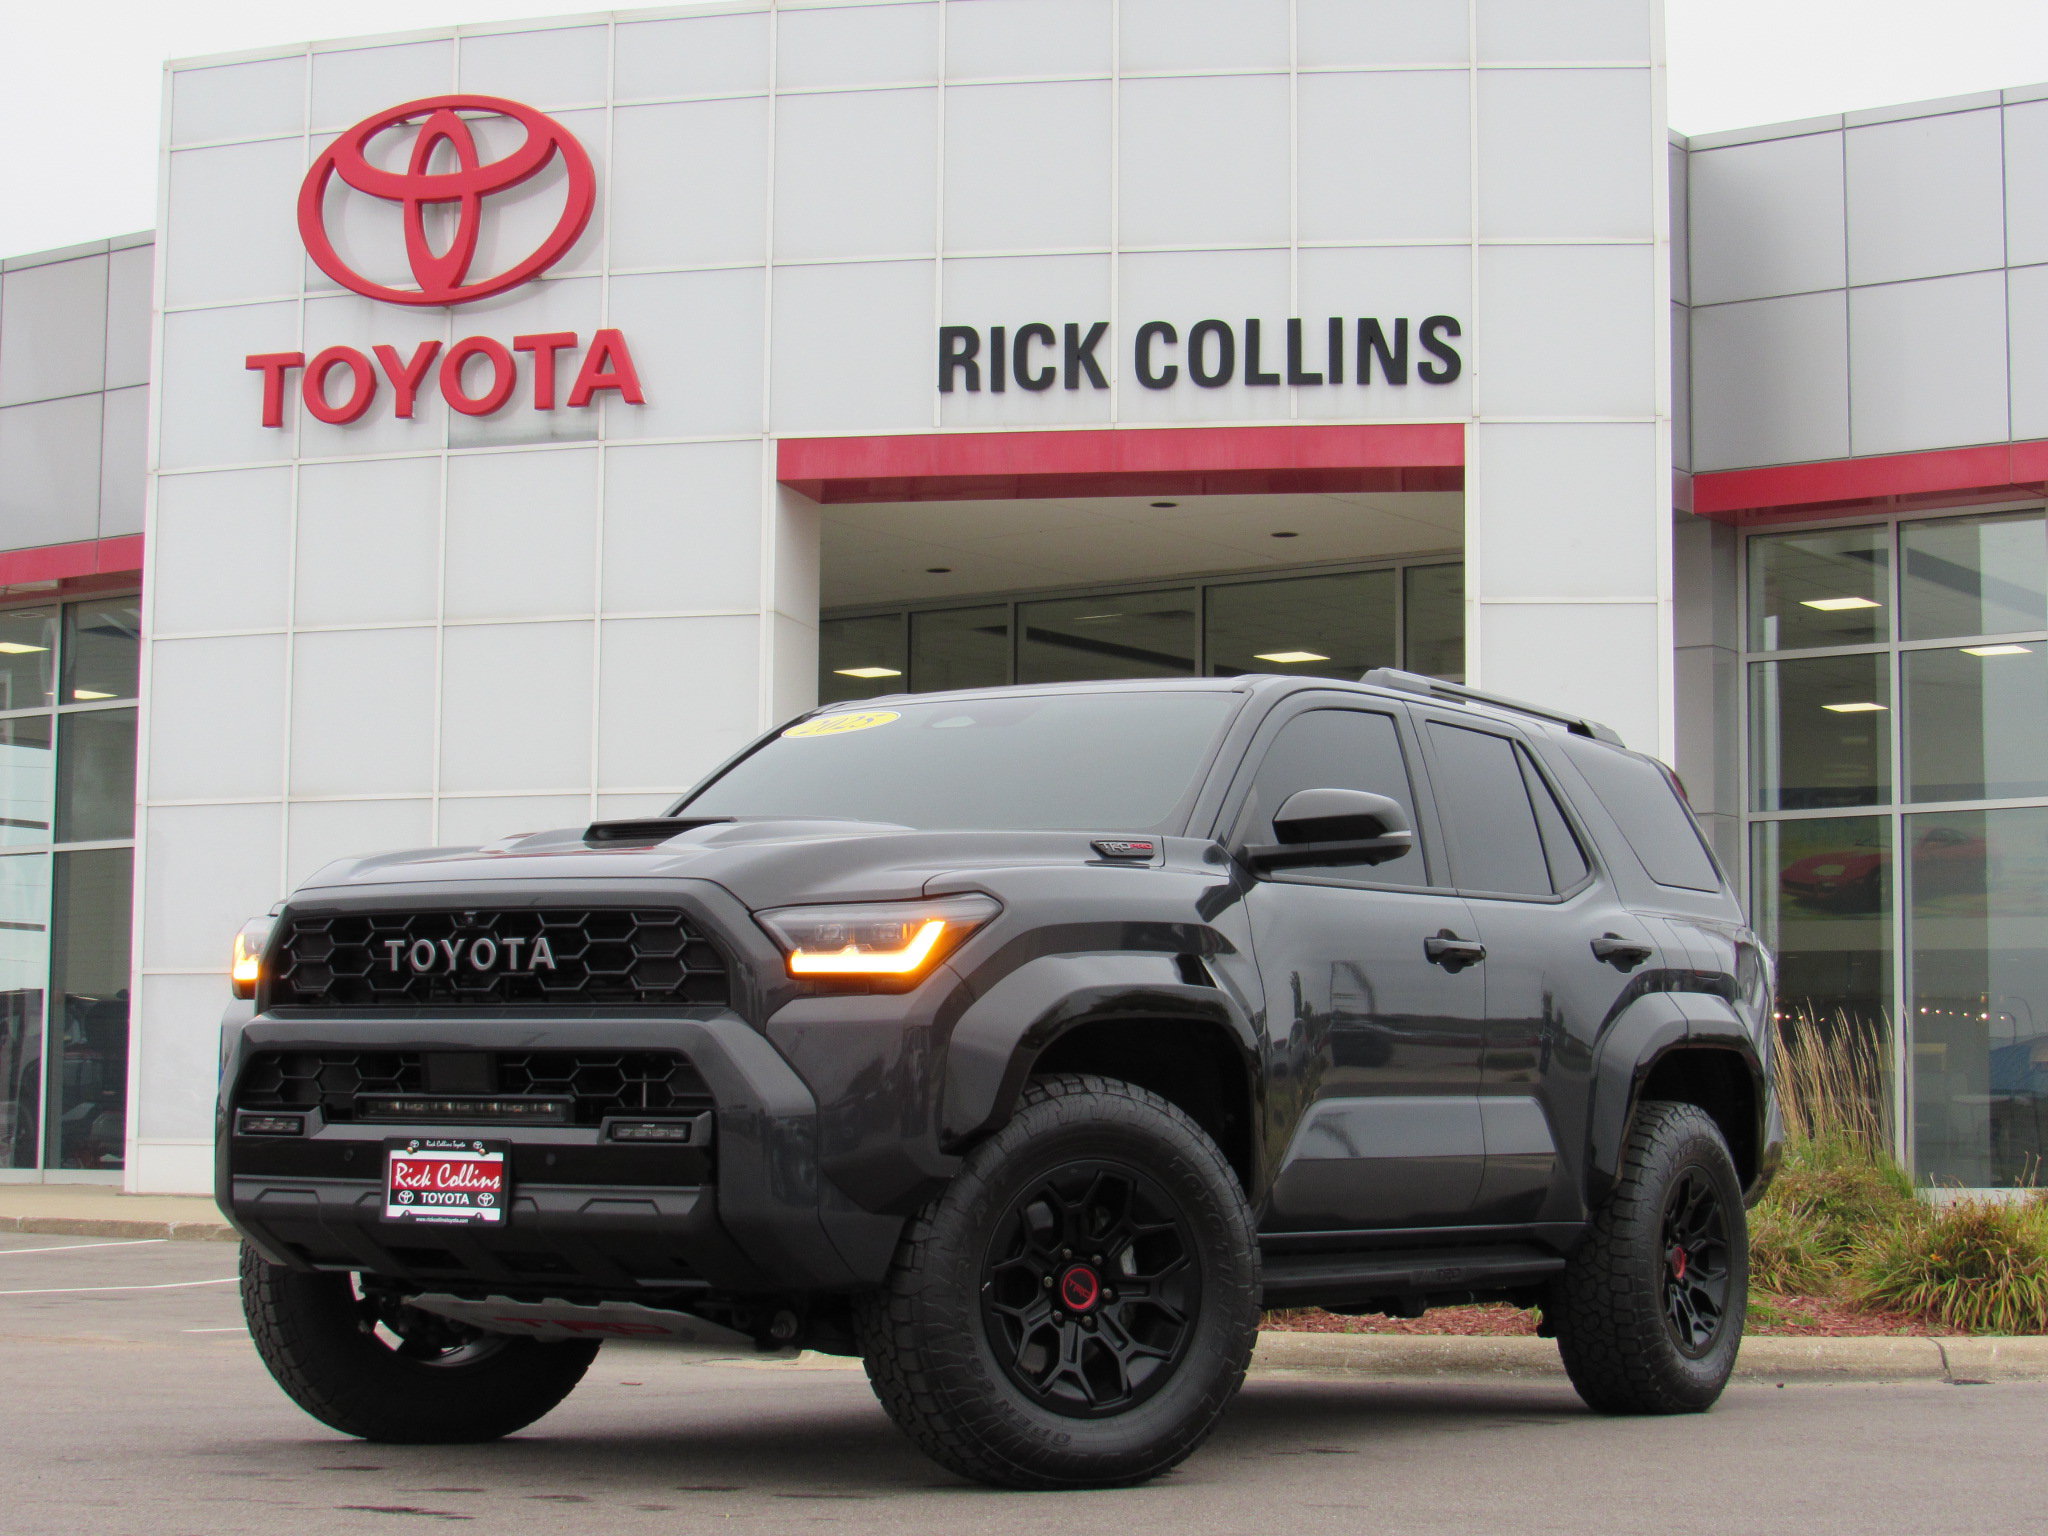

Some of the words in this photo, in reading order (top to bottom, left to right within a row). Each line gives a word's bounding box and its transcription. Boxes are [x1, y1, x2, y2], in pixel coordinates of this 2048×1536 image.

[938, 321, 1111, 394] RICK
[1134, 315, 1463, 391] COLLINS
[245, 328, 647, 429] TOYOTA
[384, 938, 557, 972] TOYOTA
[395, 1162, 432, 1188] Rick
[437, 1163, 501, 1189] Collins
[420, 1192, 470, 1205] TOYOTA
[1069, 1278, 1093, 1299] TRD
[494, 1316, 673, 1335] TRD
